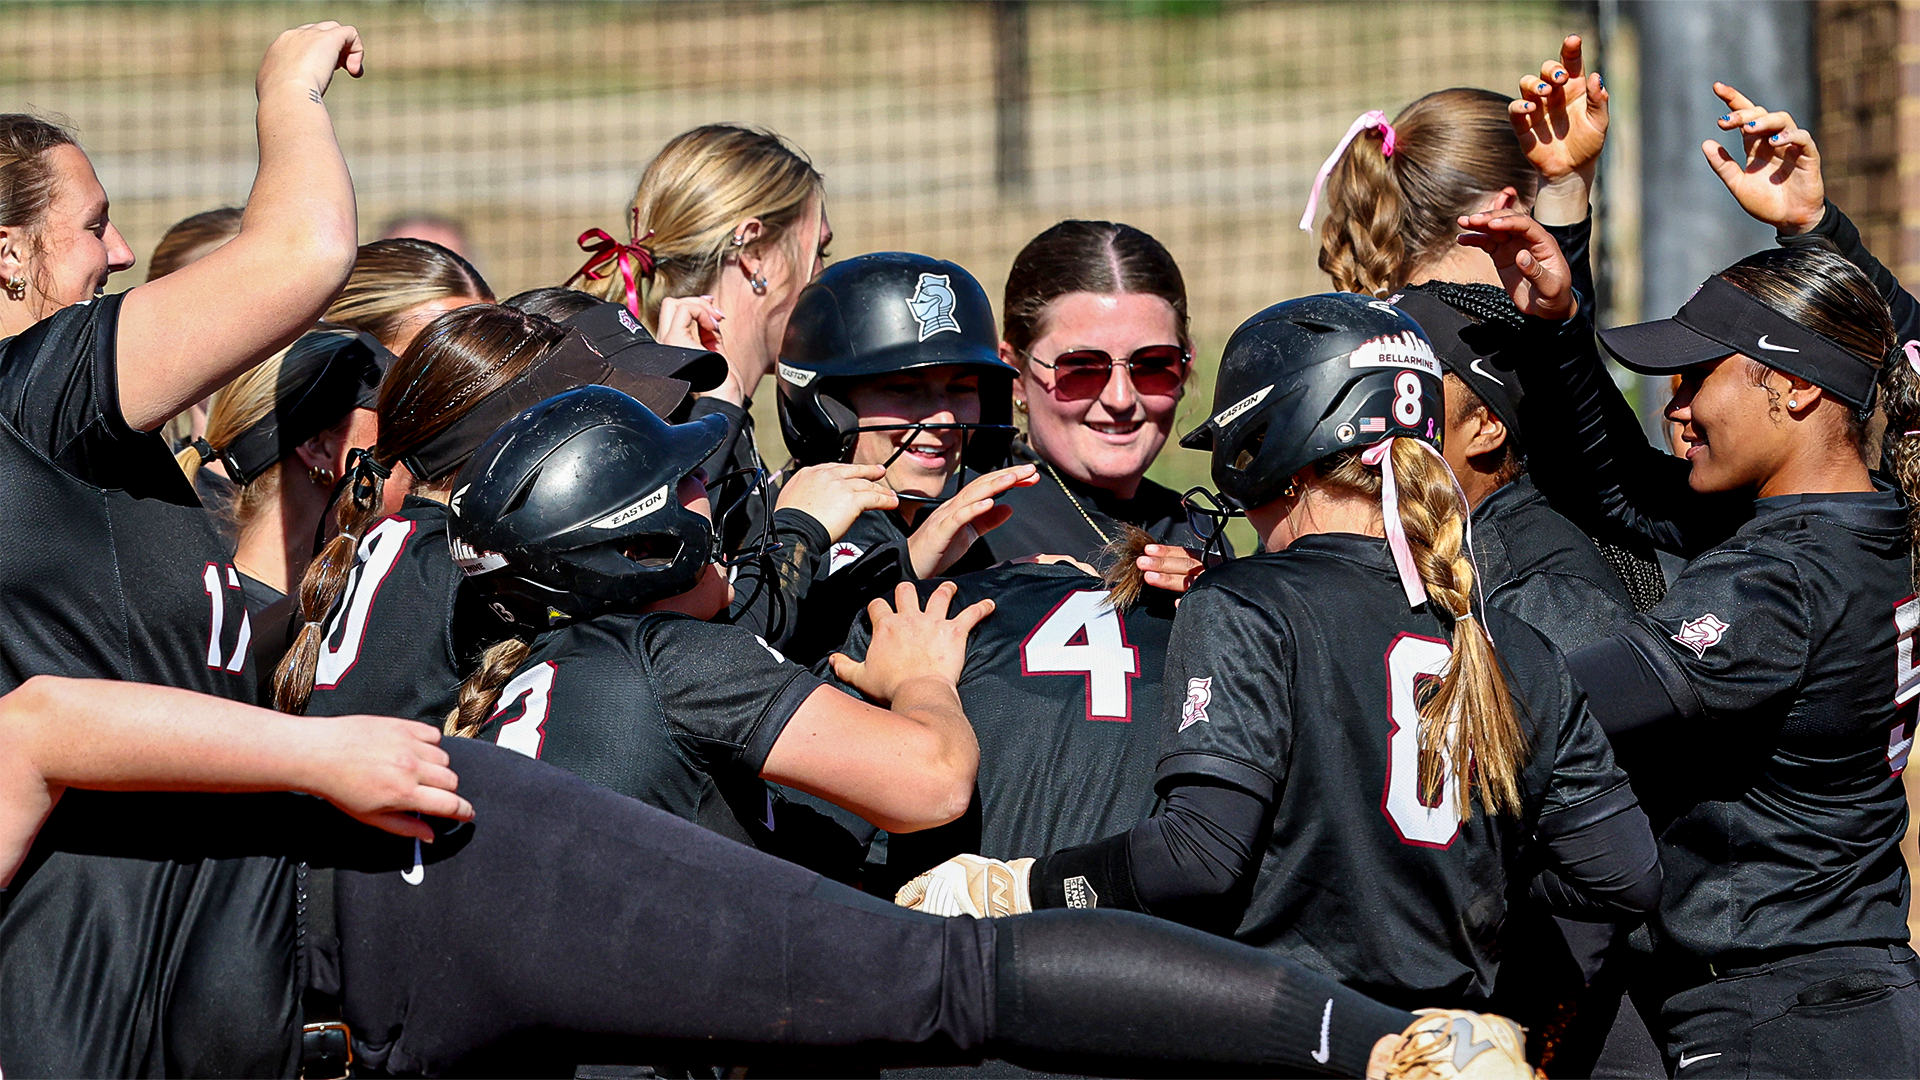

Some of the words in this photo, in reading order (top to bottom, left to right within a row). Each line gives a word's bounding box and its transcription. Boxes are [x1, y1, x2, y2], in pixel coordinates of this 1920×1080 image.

[1378, 353, 1434, 371] BELLARMINE
[1218, 394, 1259, 423] EASTON
[1392, 370, 1424, 428] 8
[612, 492, 662, 525] EASTON
[202, 561, 252, 675] 17
[1019, 588, 1141, 722] 4
